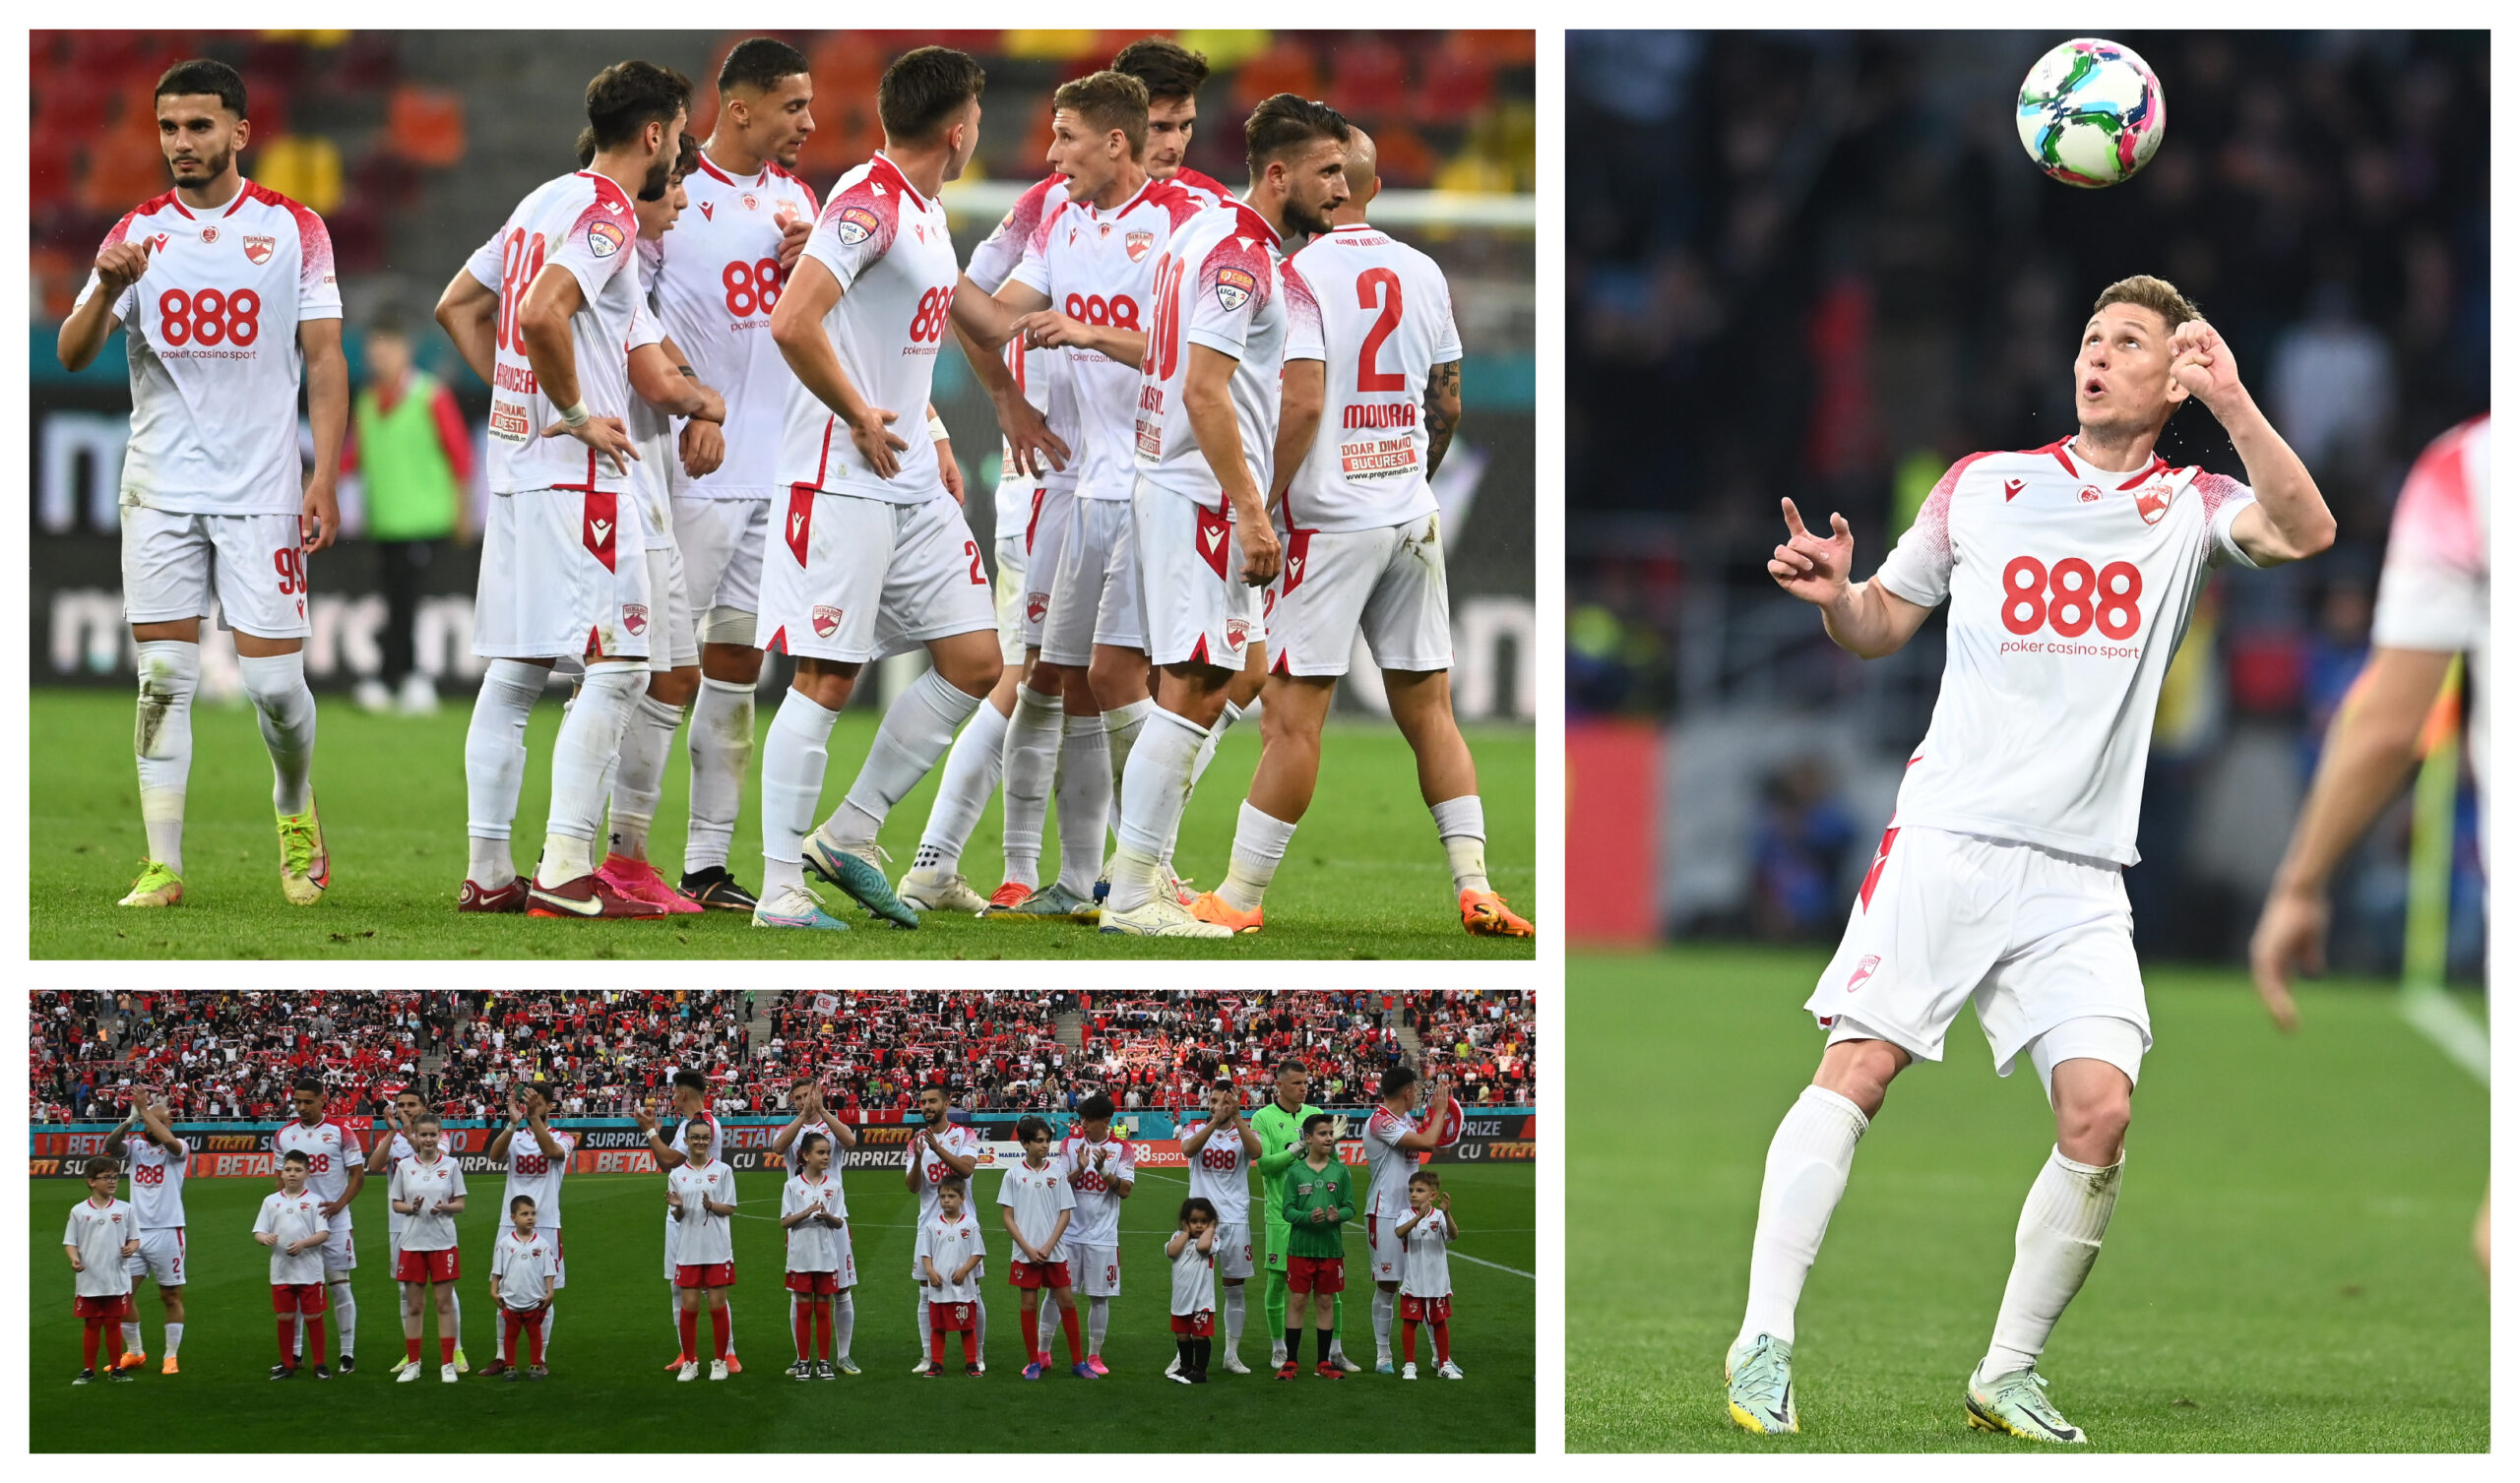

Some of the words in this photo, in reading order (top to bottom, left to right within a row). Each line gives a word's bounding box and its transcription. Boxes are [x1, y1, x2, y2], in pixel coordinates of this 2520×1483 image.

[843, 223, 857, 234] LIGA
[591, 235, 607, 247] LIGA
[1231, 272, 1253, 285] casa
[723, 257, 791, 318] 88
[1220, 287, 1236, 297] LIGA
[159, 287, 261, 347] 888
[1356, 267, 1406, 393] 2
[161, 349, 190, 360] poker
[191, 348, 228, 359] casino
[229, 349, 257, 362] sport
[903, 344, 922, 356] poker
[1343, 402, 1416, 429] MOURA
[1341, 442, 1375, 458] DOAR
[1351, 452, 1411, 470] BUCURESTI
[274, 547, 307, 595] 99
[965, 540, 986, 586] 2
[2001, 555, 2143, 641] 888
[2000, 639, 2045, 655] poker
[2047, 642, 2098, 656] casino
[2100, 645, 2140, 659] sport
[1461, 1120, 1502, 1137] PRIZE
[586, 1132, 650, 1148] SURPRIZ
[843, 1150, 908, 1167] URPRIZE
[1203, 1147, 1236, 1170] 888
[1458, 1143, 1481, 1159] CU
[217, 1154, 277, 1176] BETA
[307, 1152, 330, 1174] 88
[516, 1154, 548, 1174] 888
[597, 1151, 659, 1173] BETA
[732, 1152, 756, 1168] CU
[135, 1163, 164, 1185] 888
[172, 1258, 181, 1273] 2
[447, 1253, 454, 1267] 9
[847, 1254, 851, 1271] 6
[955, 1305, 969, 1320] 30
